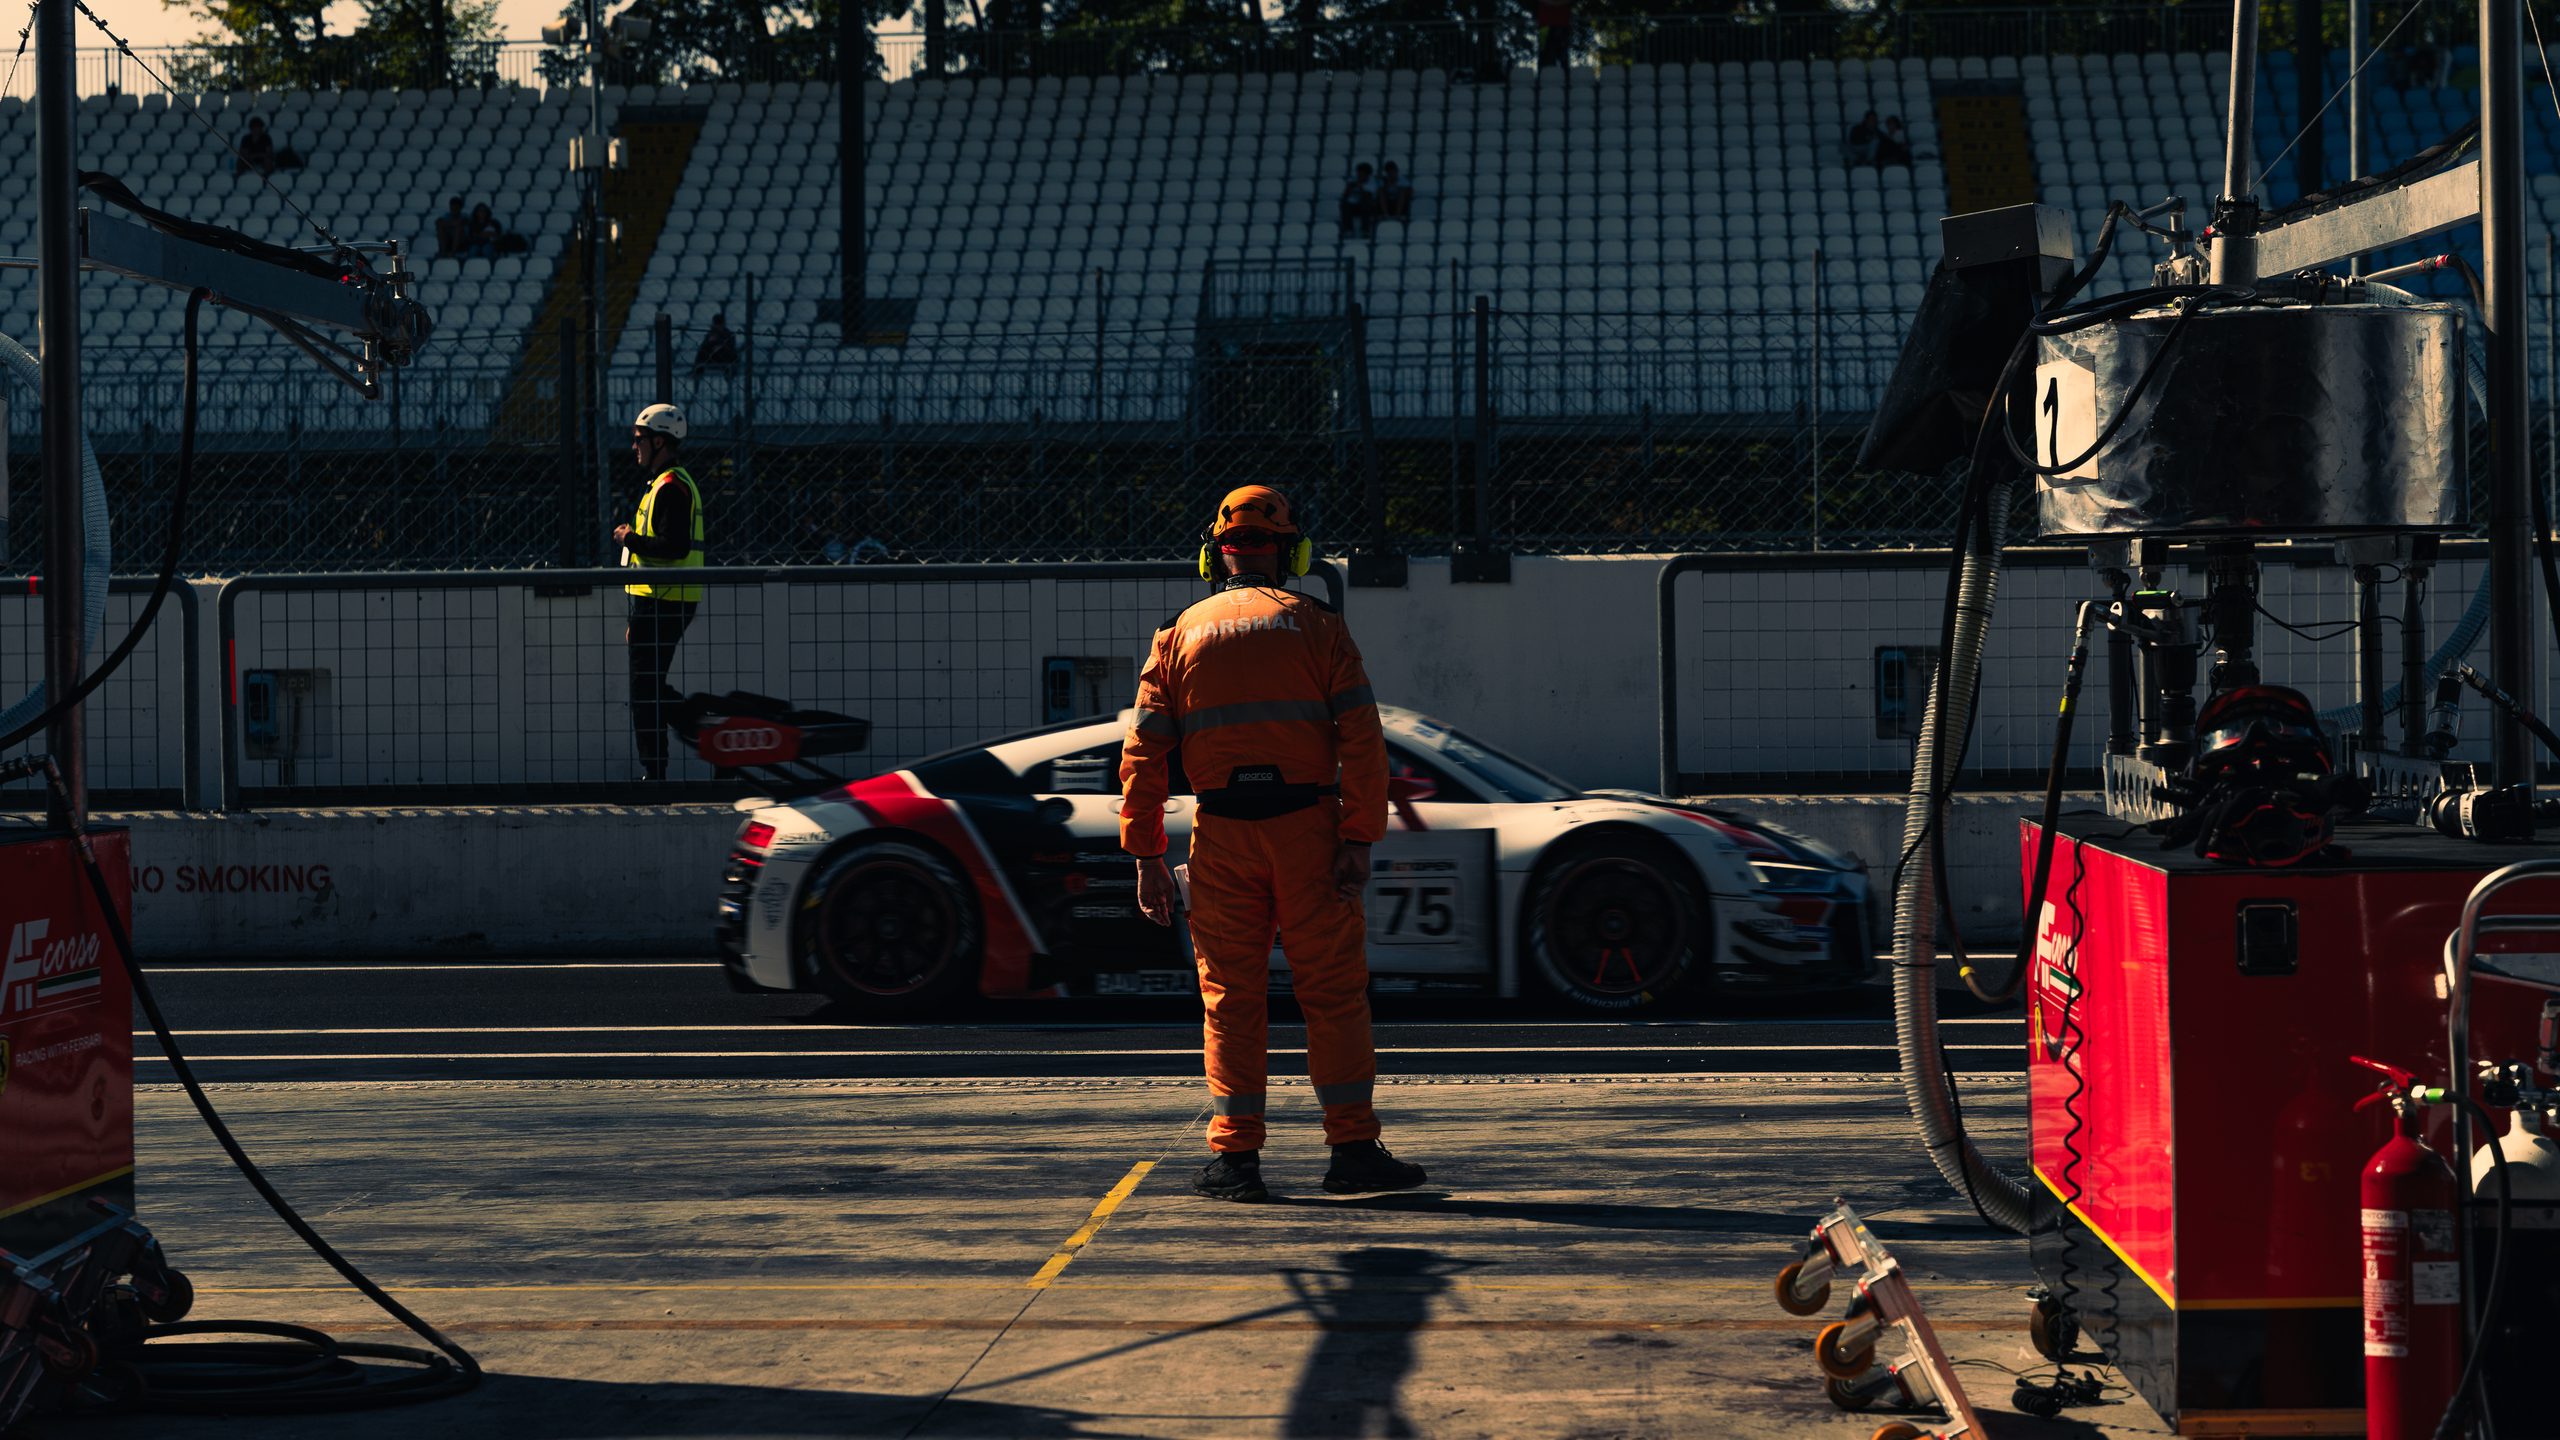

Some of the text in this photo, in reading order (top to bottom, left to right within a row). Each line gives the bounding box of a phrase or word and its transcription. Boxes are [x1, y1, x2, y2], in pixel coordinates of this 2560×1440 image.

[2043, 377, 2059, 468] 1
[1185, 614, 1301, 645] MARSHAL
[1238, 772, 1273, 782] sparco
[176, 864, 330, 894] SMOKING
[1376, 886, 1454, 936] 75
[42, 932, 102, 976] corse
[16, 1033, 102, 1067] RACING WITH FERRARI
